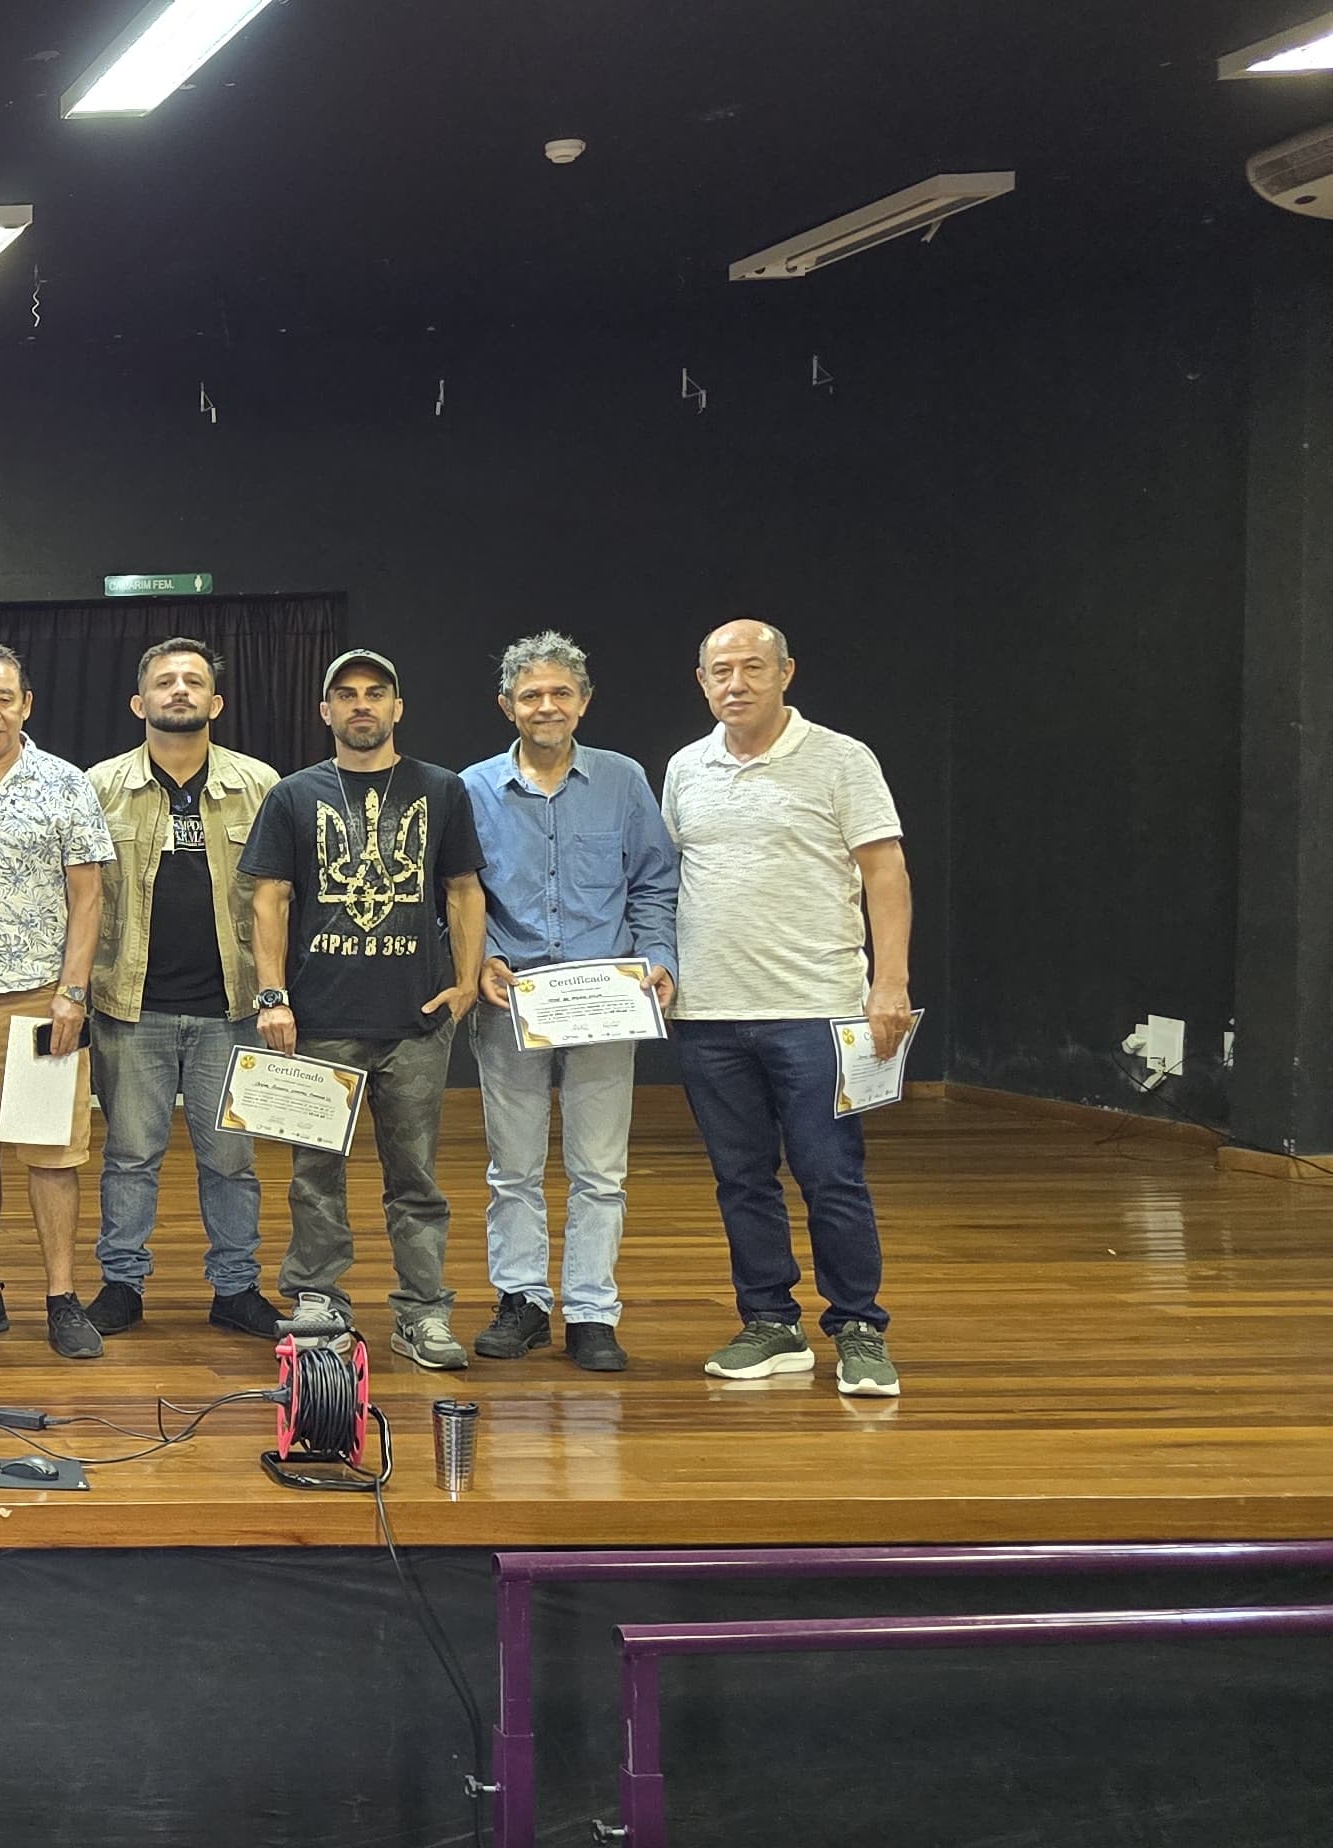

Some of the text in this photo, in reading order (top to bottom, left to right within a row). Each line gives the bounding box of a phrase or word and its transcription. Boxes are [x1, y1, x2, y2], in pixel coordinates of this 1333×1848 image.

[153, 579, 175, 590] FEM.
[548, 973, 611, 988] Certificado
[267, 1063, 324, 1083] Certificado
